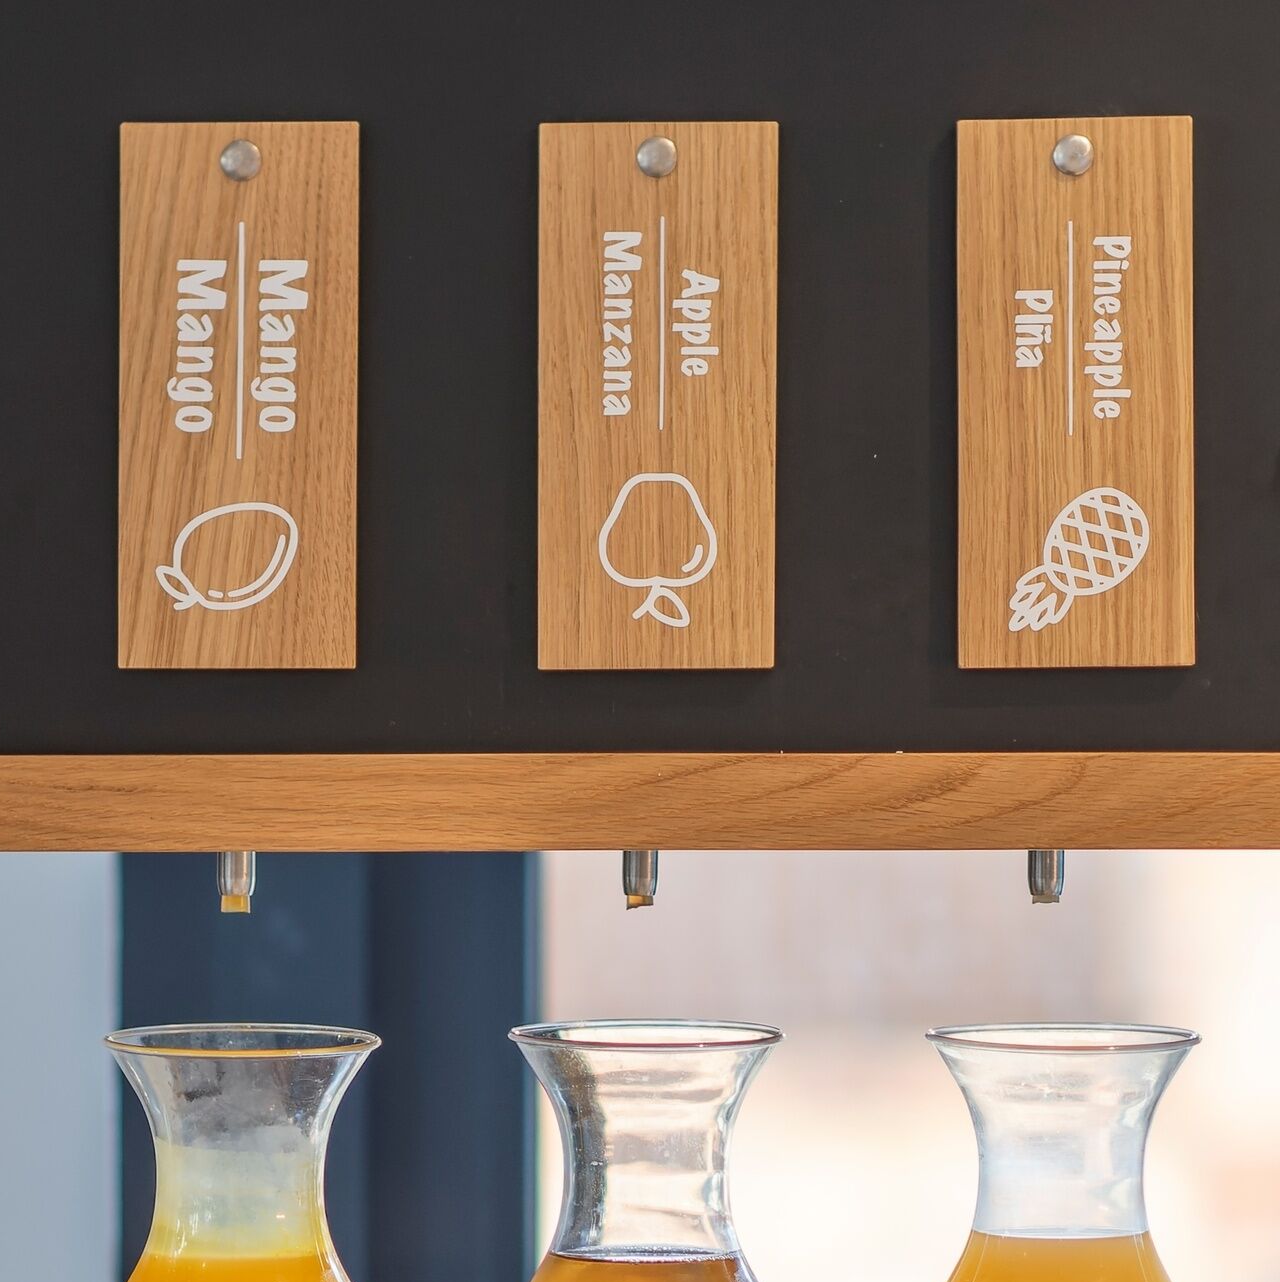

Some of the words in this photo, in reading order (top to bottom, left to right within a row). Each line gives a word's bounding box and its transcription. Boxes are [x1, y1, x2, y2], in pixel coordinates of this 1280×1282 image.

[166, 259, 227, 433] Mango
[250, 259, 309, 433] Mango
[602, 231, 643, 416] Manzana
[671, 268, 720, 377] Apple
[1083, 235, 1132, 419] Pineapple
